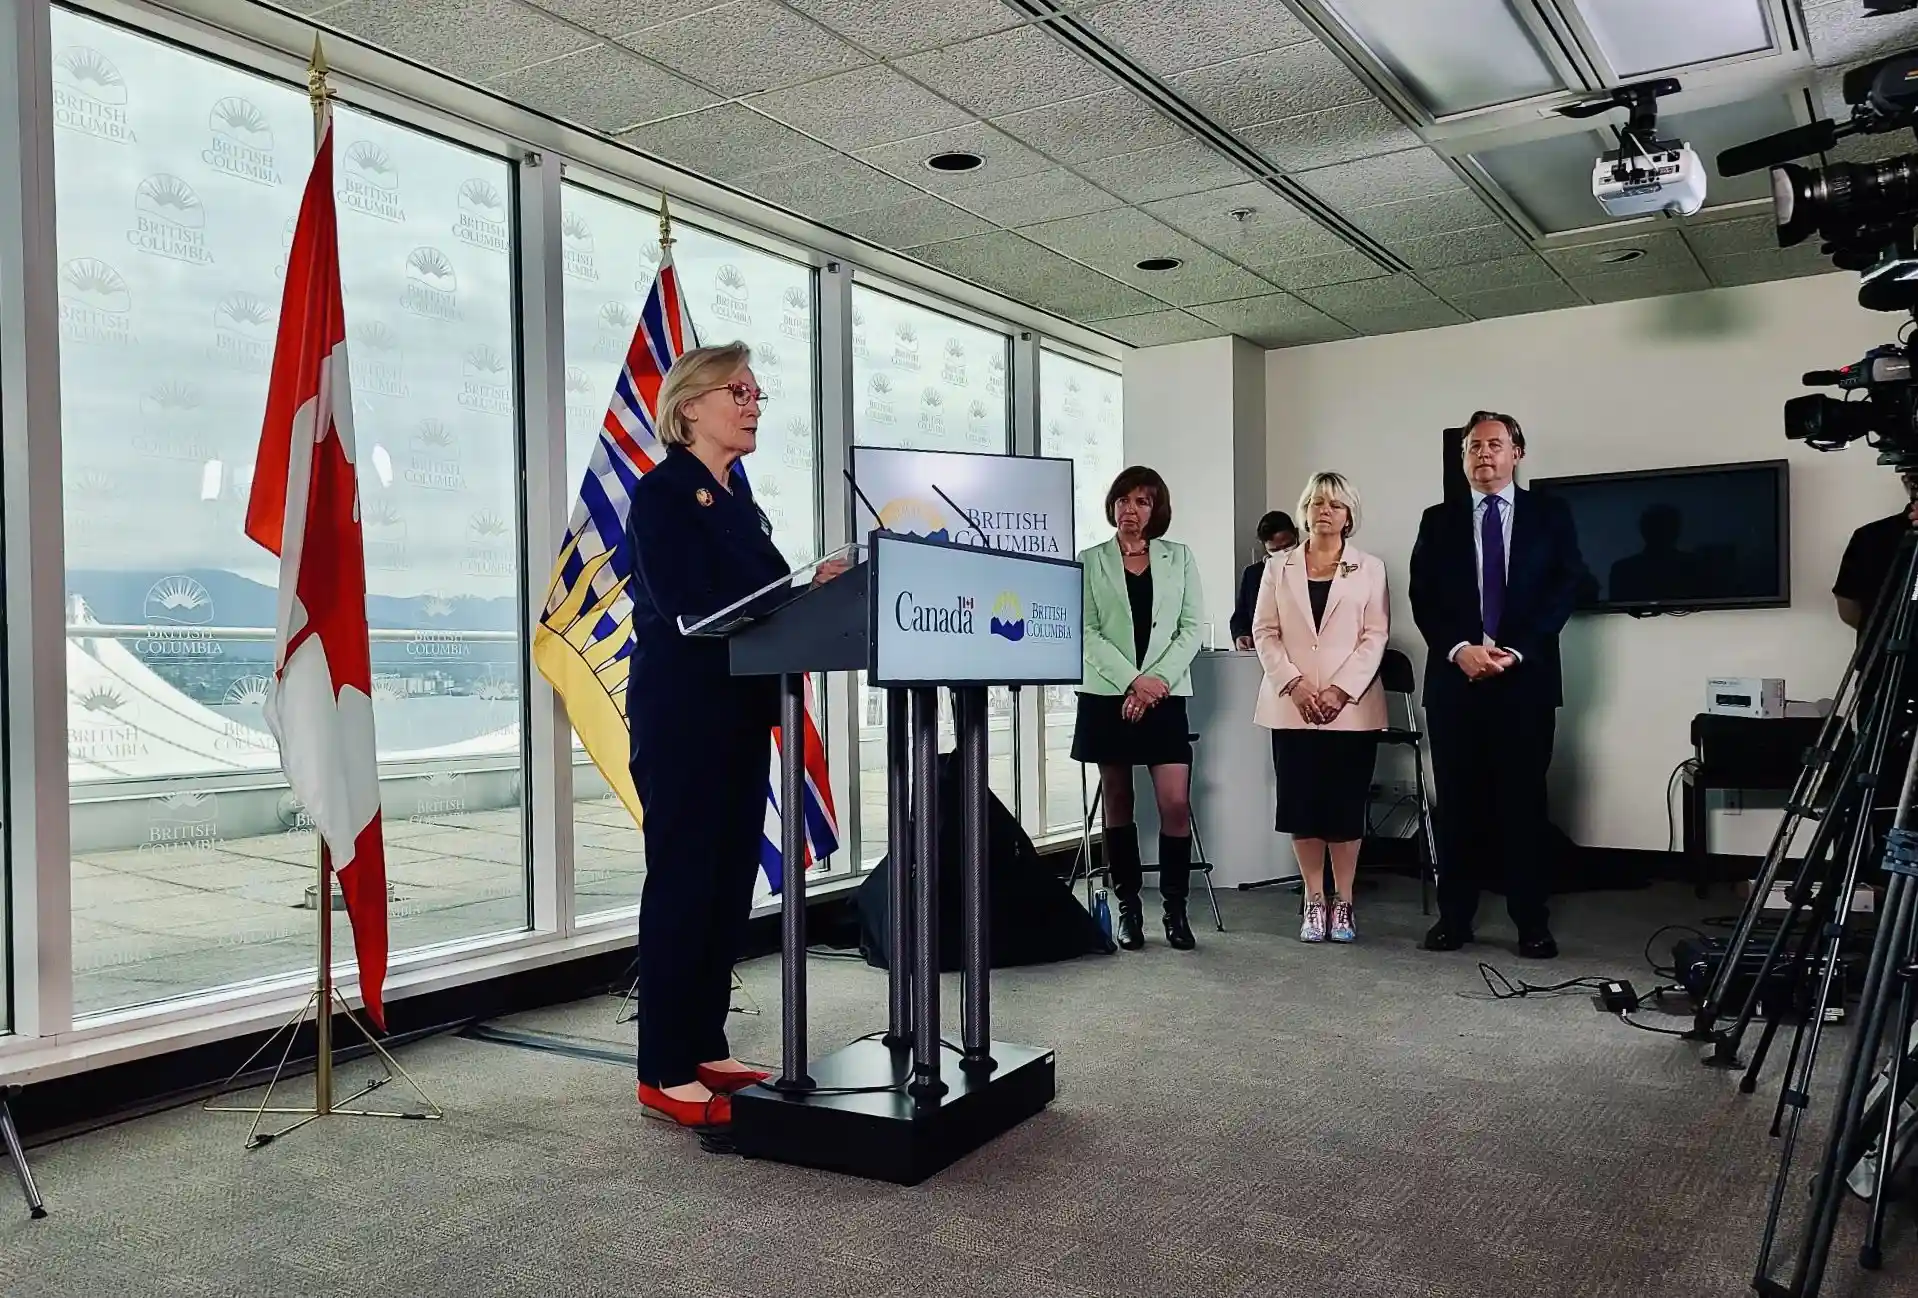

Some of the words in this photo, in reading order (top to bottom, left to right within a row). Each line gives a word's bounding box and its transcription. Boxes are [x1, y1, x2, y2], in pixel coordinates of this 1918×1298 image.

[54, 89, 128, 124] BRITISH
[55, 108, 138, 143] OLUMBIA
[212, 137, 275, 168] BRITISH
[201, 149, 283, 186] COLUMBIA
[345, 177, 401, 206] BRITISH
[336, 190, 406, 222] COLUMBIA
[138, 217, 205, 247] BRITISH
[459, 213, 505, 238] BRITISH
[126, 229, 215, 264] COLUMBIA
[464, 381, 510, 400] BRITISH
[967, 508, 1048, 531] BRITISH
[955, 530, 1060, 553] COLUMBIA
[895, 590, 975, 635] Canada
[1032, 602, 1068, 621] BRITISH
[1026, 619, 1073, 639] COLUMBIA
[135, 639, 223, 655] COLUMBIA
[406, 643, 471, 656] COLUMBIA
[417, 800, 465, 814] BRITISH
[150, 823, 217, 842] BRITISH
